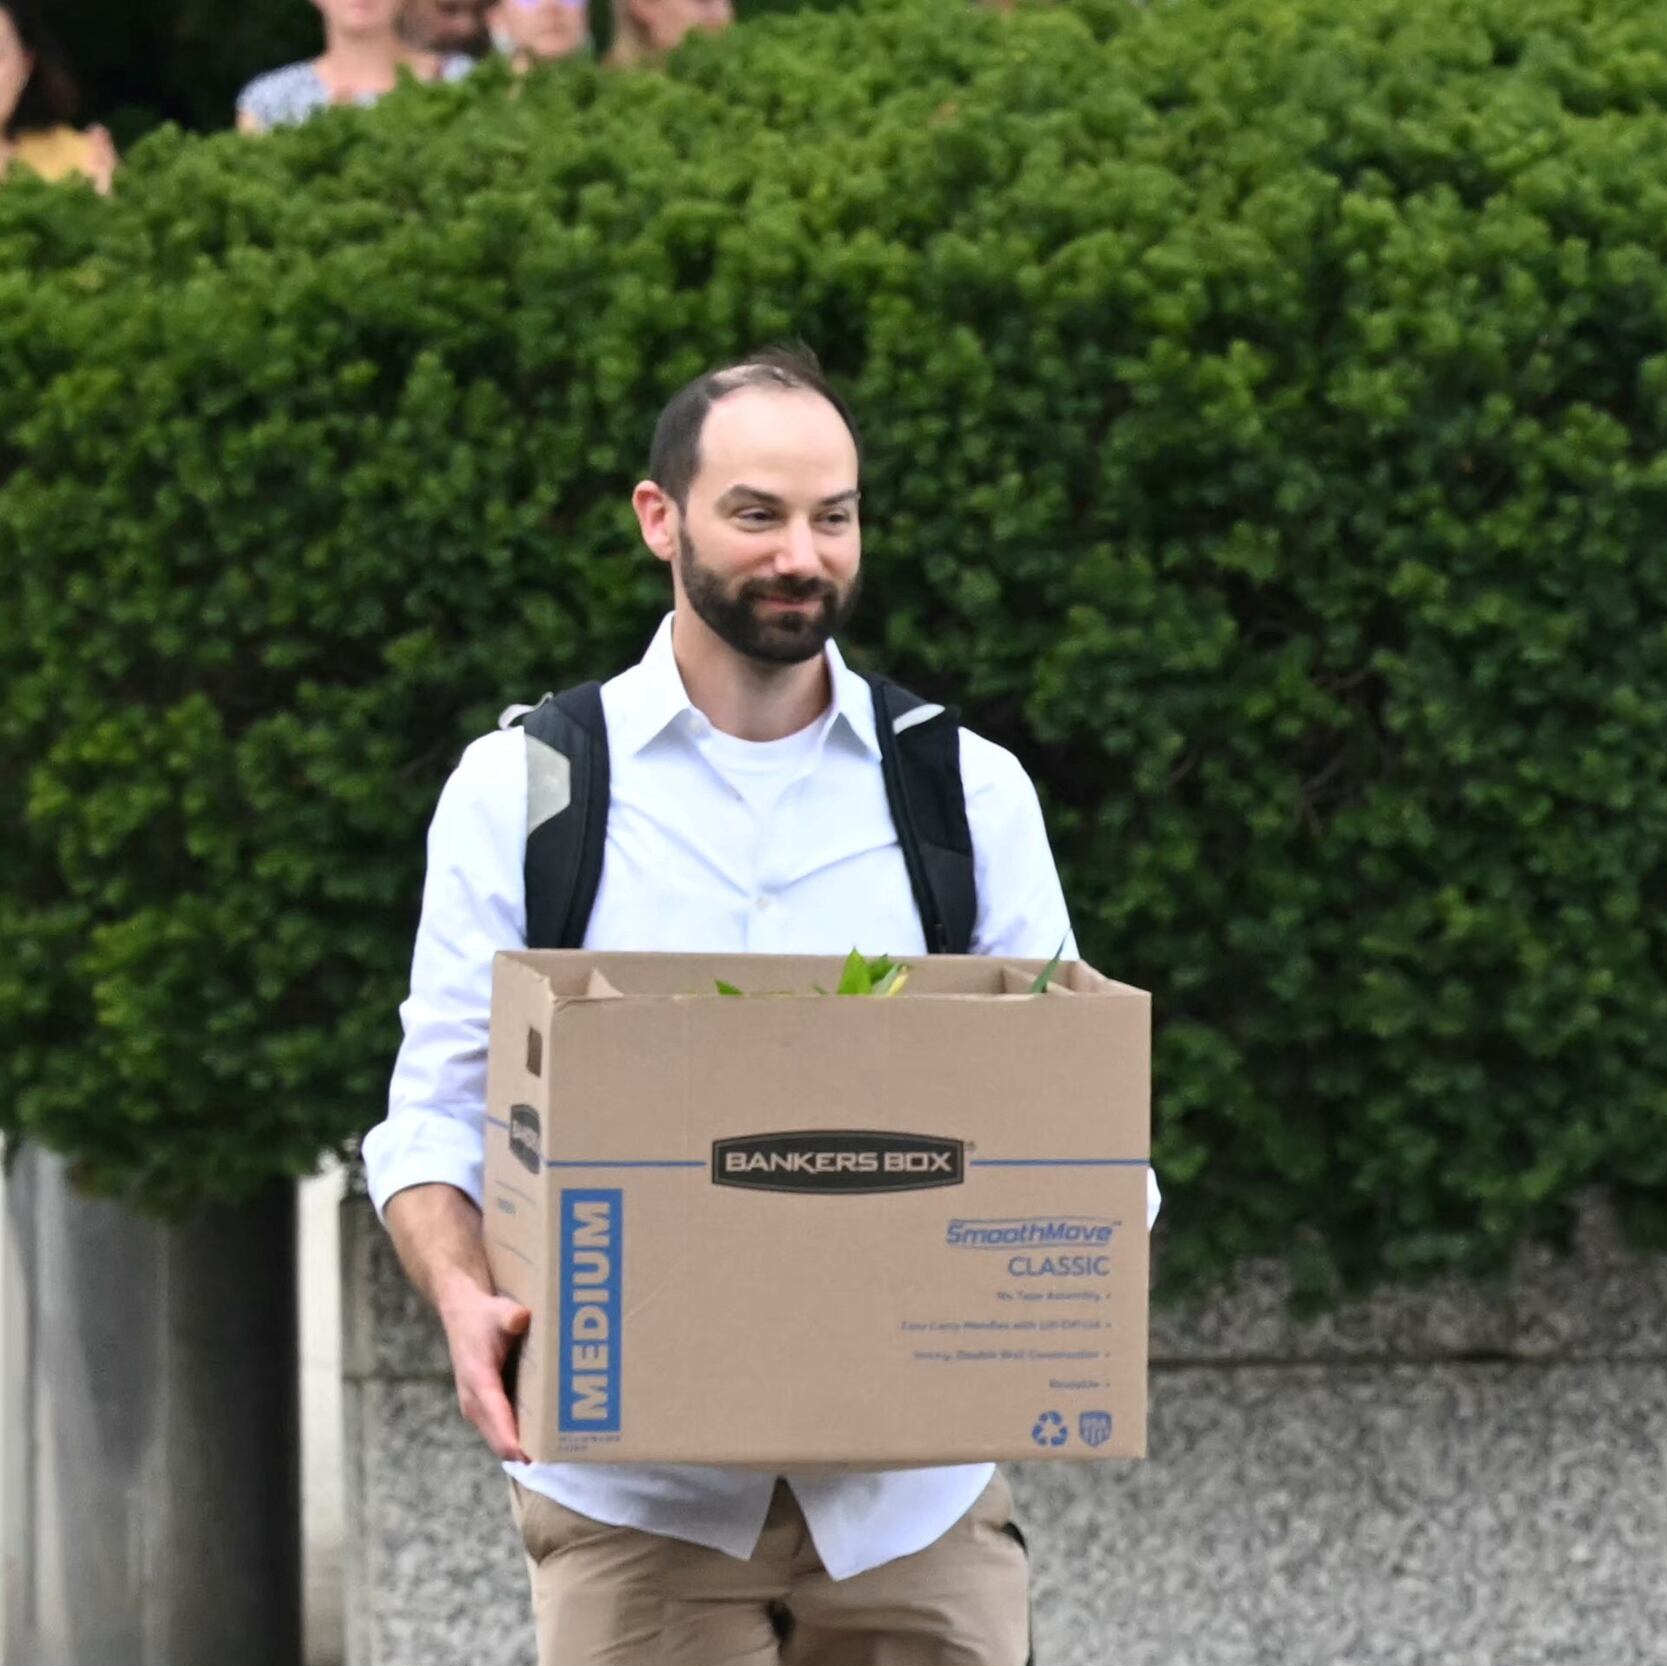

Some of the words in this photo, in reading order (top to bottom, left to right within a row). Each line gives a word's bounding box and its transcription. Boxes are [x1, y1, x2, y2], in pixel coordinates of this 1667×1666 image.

[725, 1152, 878, 1174] BANKERS
[884, 1152, 952, 1173] BOX
[947, 1222, 1113, 1244] SmoothMove
[1008, 1256, 1110, 1277] CLASSIC
[571, 1202, 611, 1421] MEDIUM
